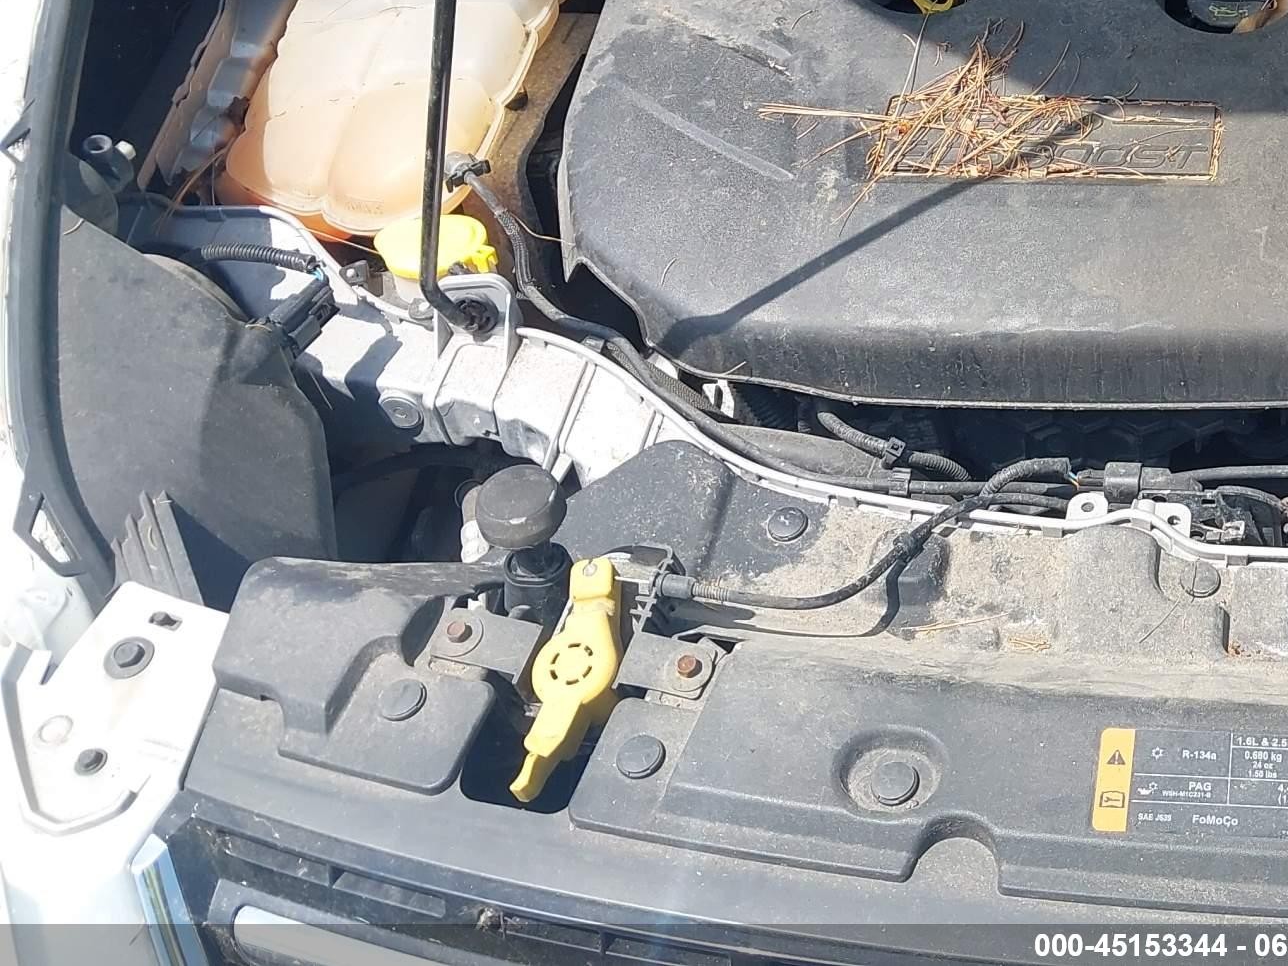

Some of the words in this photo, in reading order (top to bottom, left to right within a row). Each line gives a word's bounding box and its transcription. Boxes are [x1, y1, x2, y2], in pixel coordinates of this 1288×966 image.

[1237, 737, 1258, 746] 1.6L
[1261, 737, 1269, 746] &
[1182, 749, 1217, 762] R-134a
[1244, 751, 1268, 760] 0.680
[1271, 752, 1282, 762] kg
[1252, 761, 1262, 769] 24
[1265, 770, 1277, 778] lbs
[1188, 781, 1212, 791] PAG
[1138, 812, 1153, 821] SAE
[1192, 814, 1238, 826] FoMoCo
